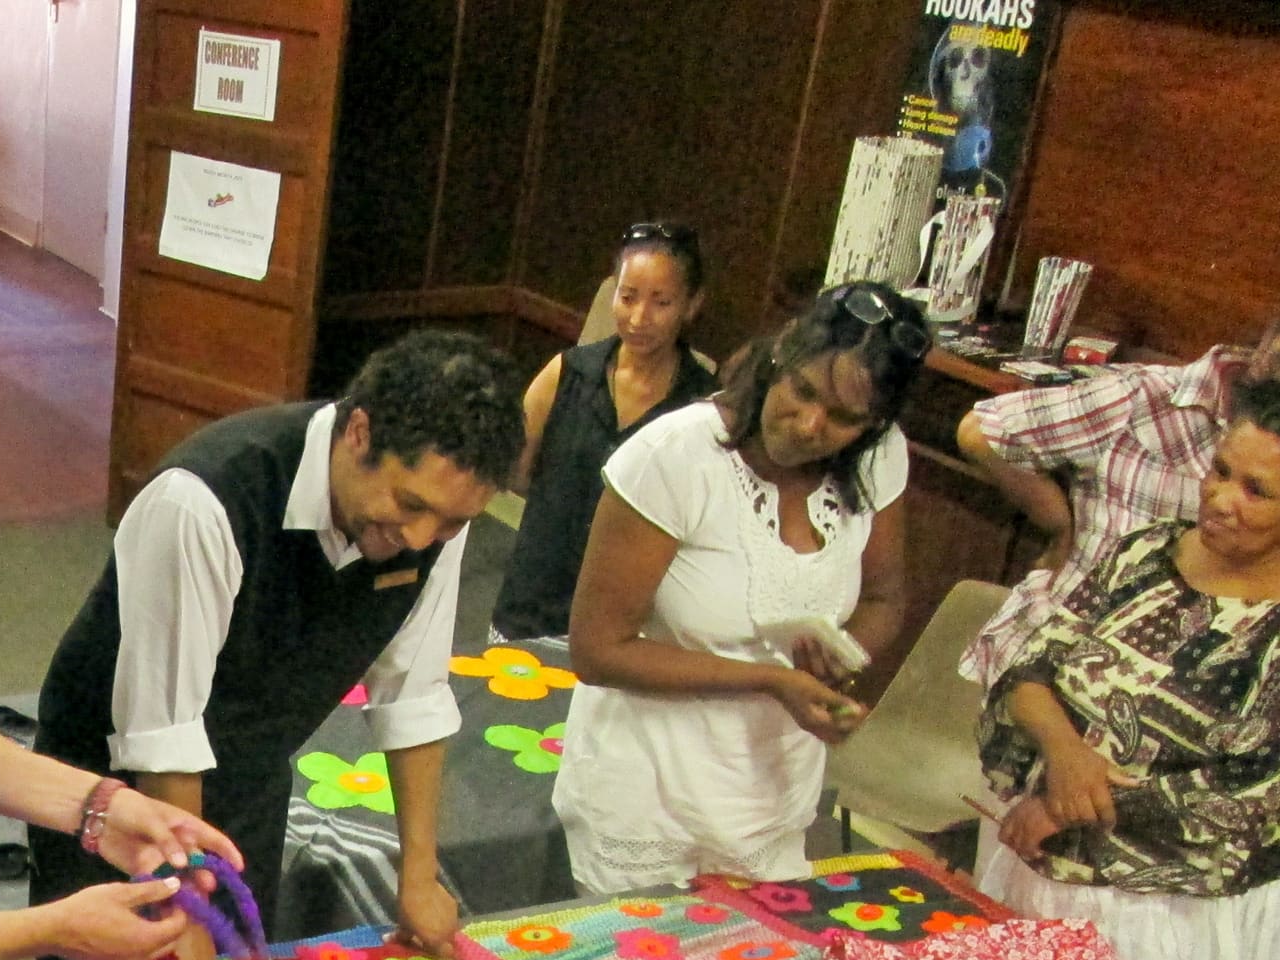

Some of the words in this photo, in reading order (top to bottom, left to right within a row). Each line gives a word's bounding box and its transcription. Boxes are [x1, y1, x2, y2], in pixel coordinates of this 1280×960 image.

[204, 40, 260, 70] CONFERENCE
[949, 25, 975, 42] are
[978, 24, 1030, 57] deadly
[217, 76, 244, 103] ROOM
